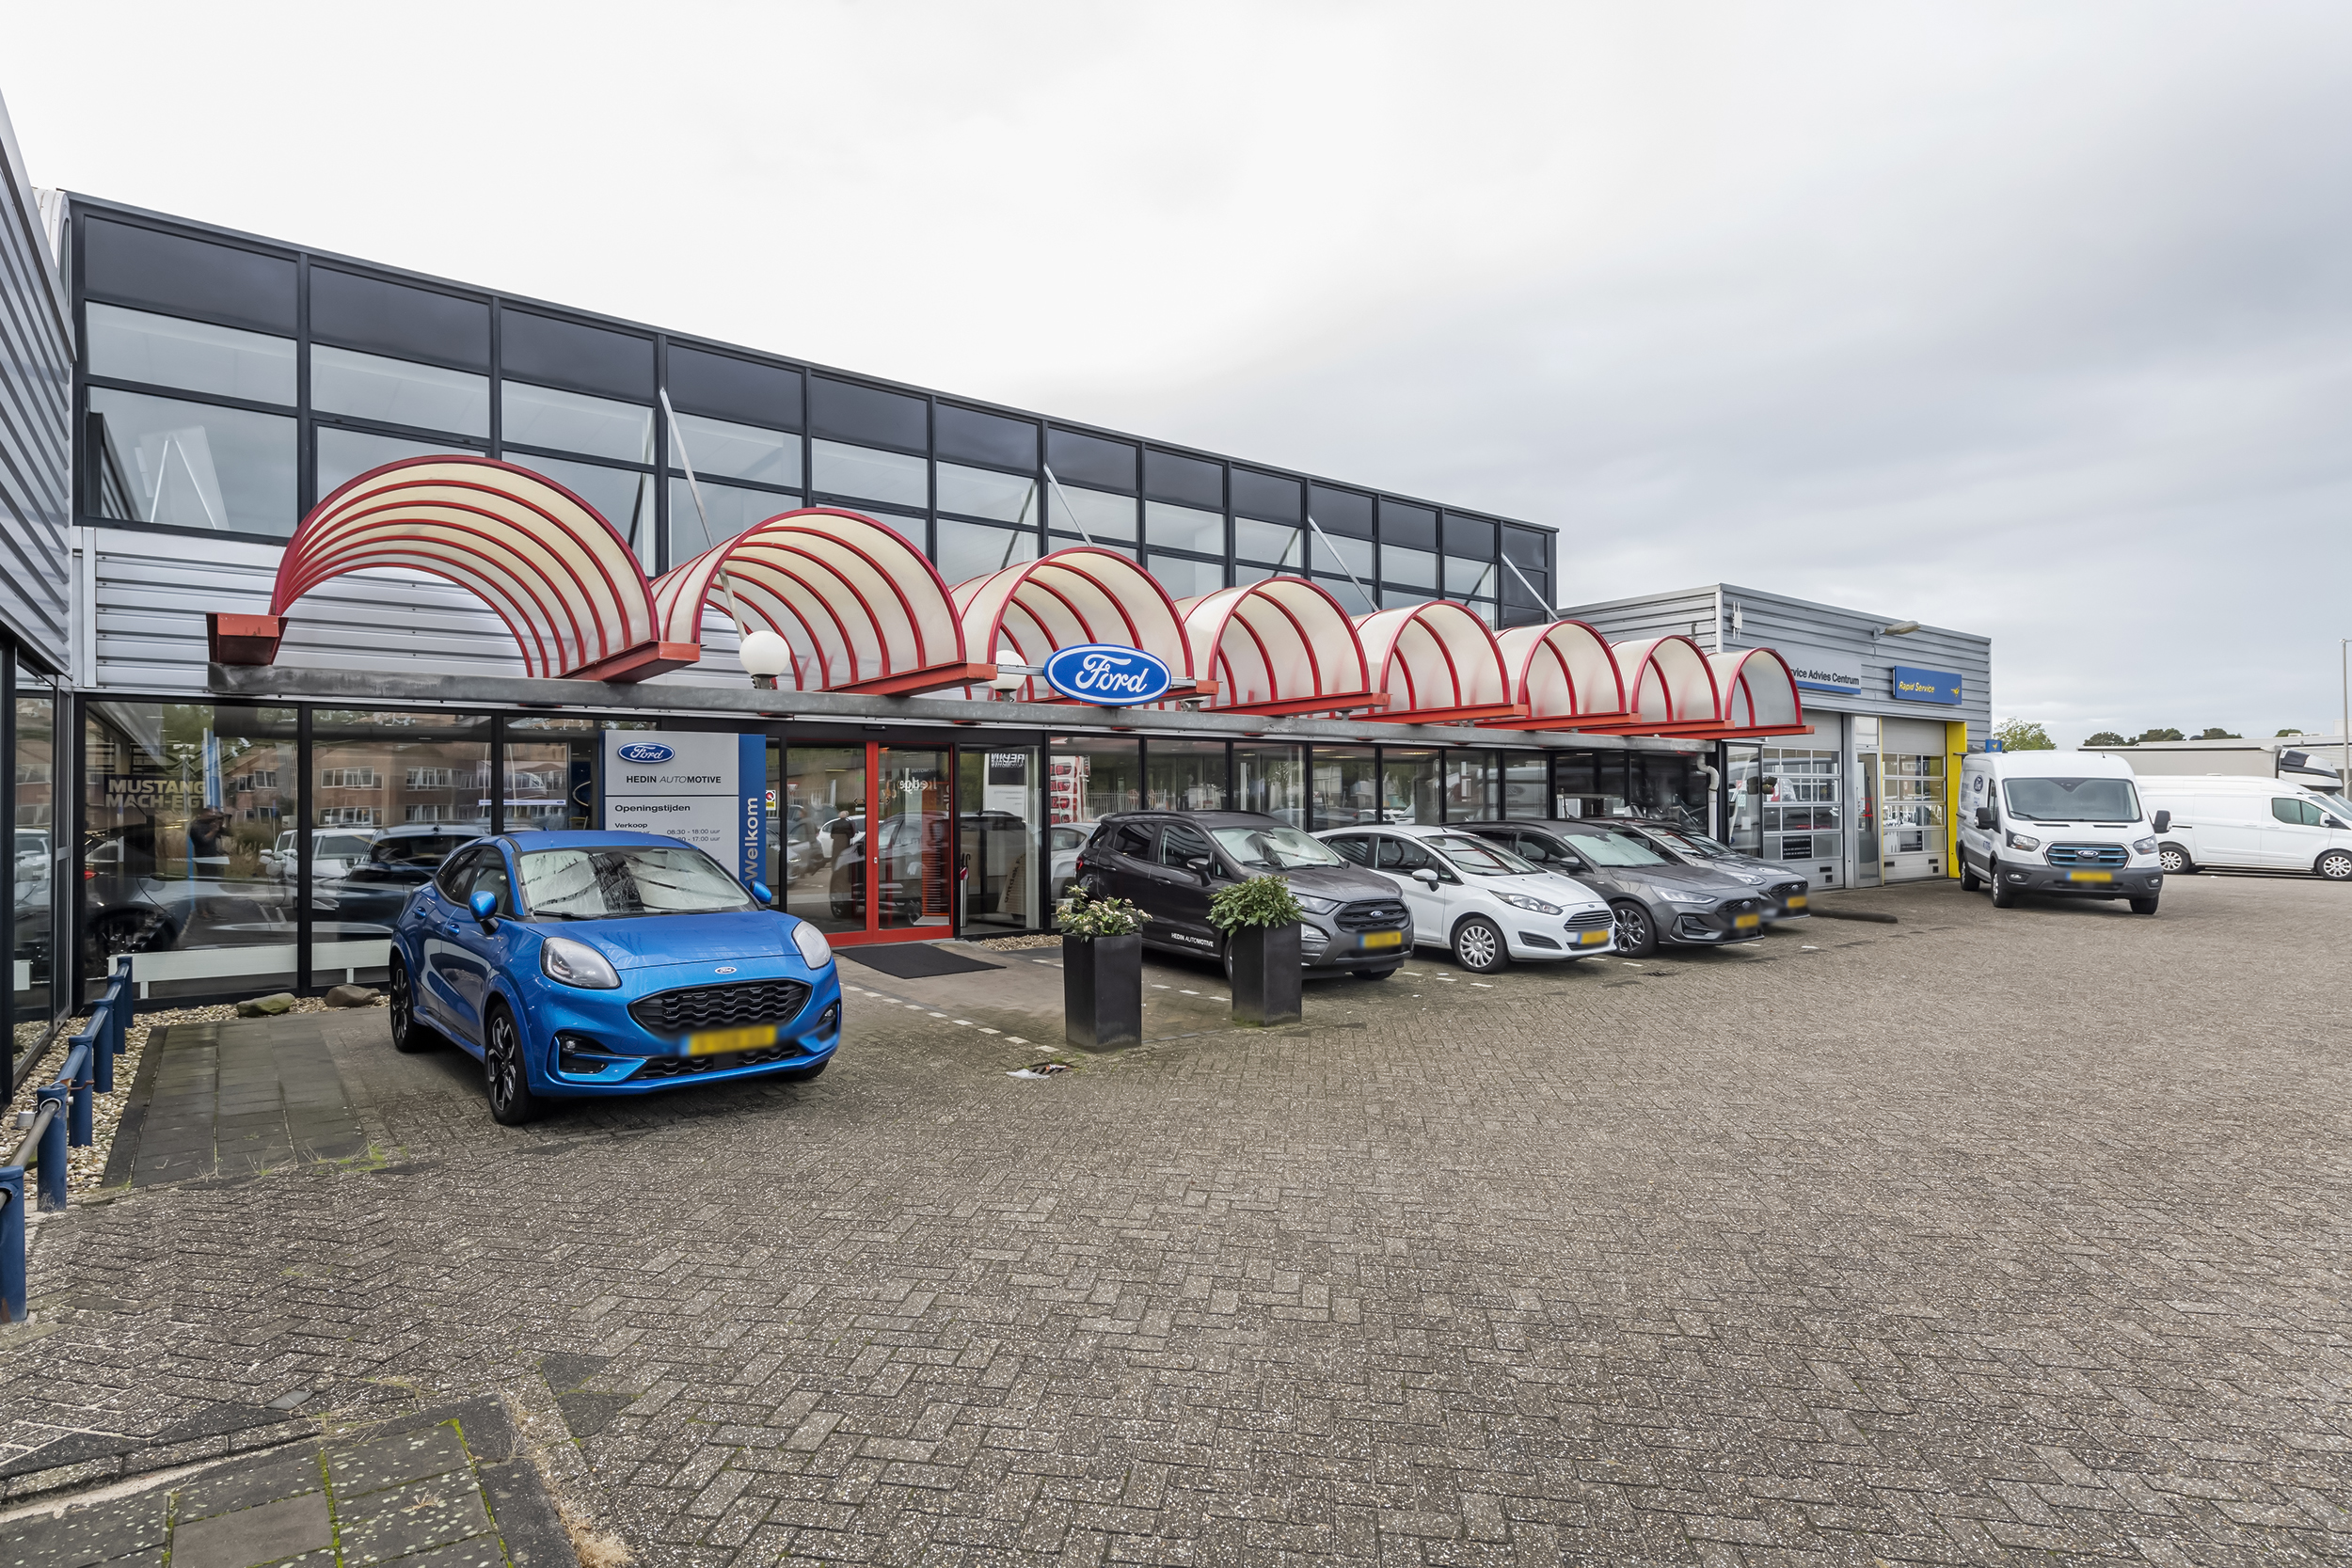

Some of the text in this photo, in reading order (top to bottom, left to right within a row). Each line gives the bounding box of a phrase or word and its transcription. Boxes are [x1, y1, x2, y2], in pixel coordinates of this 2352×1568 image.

[1075, 654, 1149, 692] Ford
[1808, 670, 1831, 682] Advies
[1832, 673, 1859, 685] Centrum
[1899, 681, 1935, 693] Rapid Service
[629, 745, 664, 759] Ford
[626, 775, 722, 784] HEDIN AUTOMOTIVE
[108, 780, 206, 794] MUSTANG
[105, 794, 183, 808] MACH-E
[614, 804, 691, 813] Openingstijden
[744, 798, 758, 881] Welkom
[1171, 932, 1214, 947] HEDIN AUTOMOTIVE
